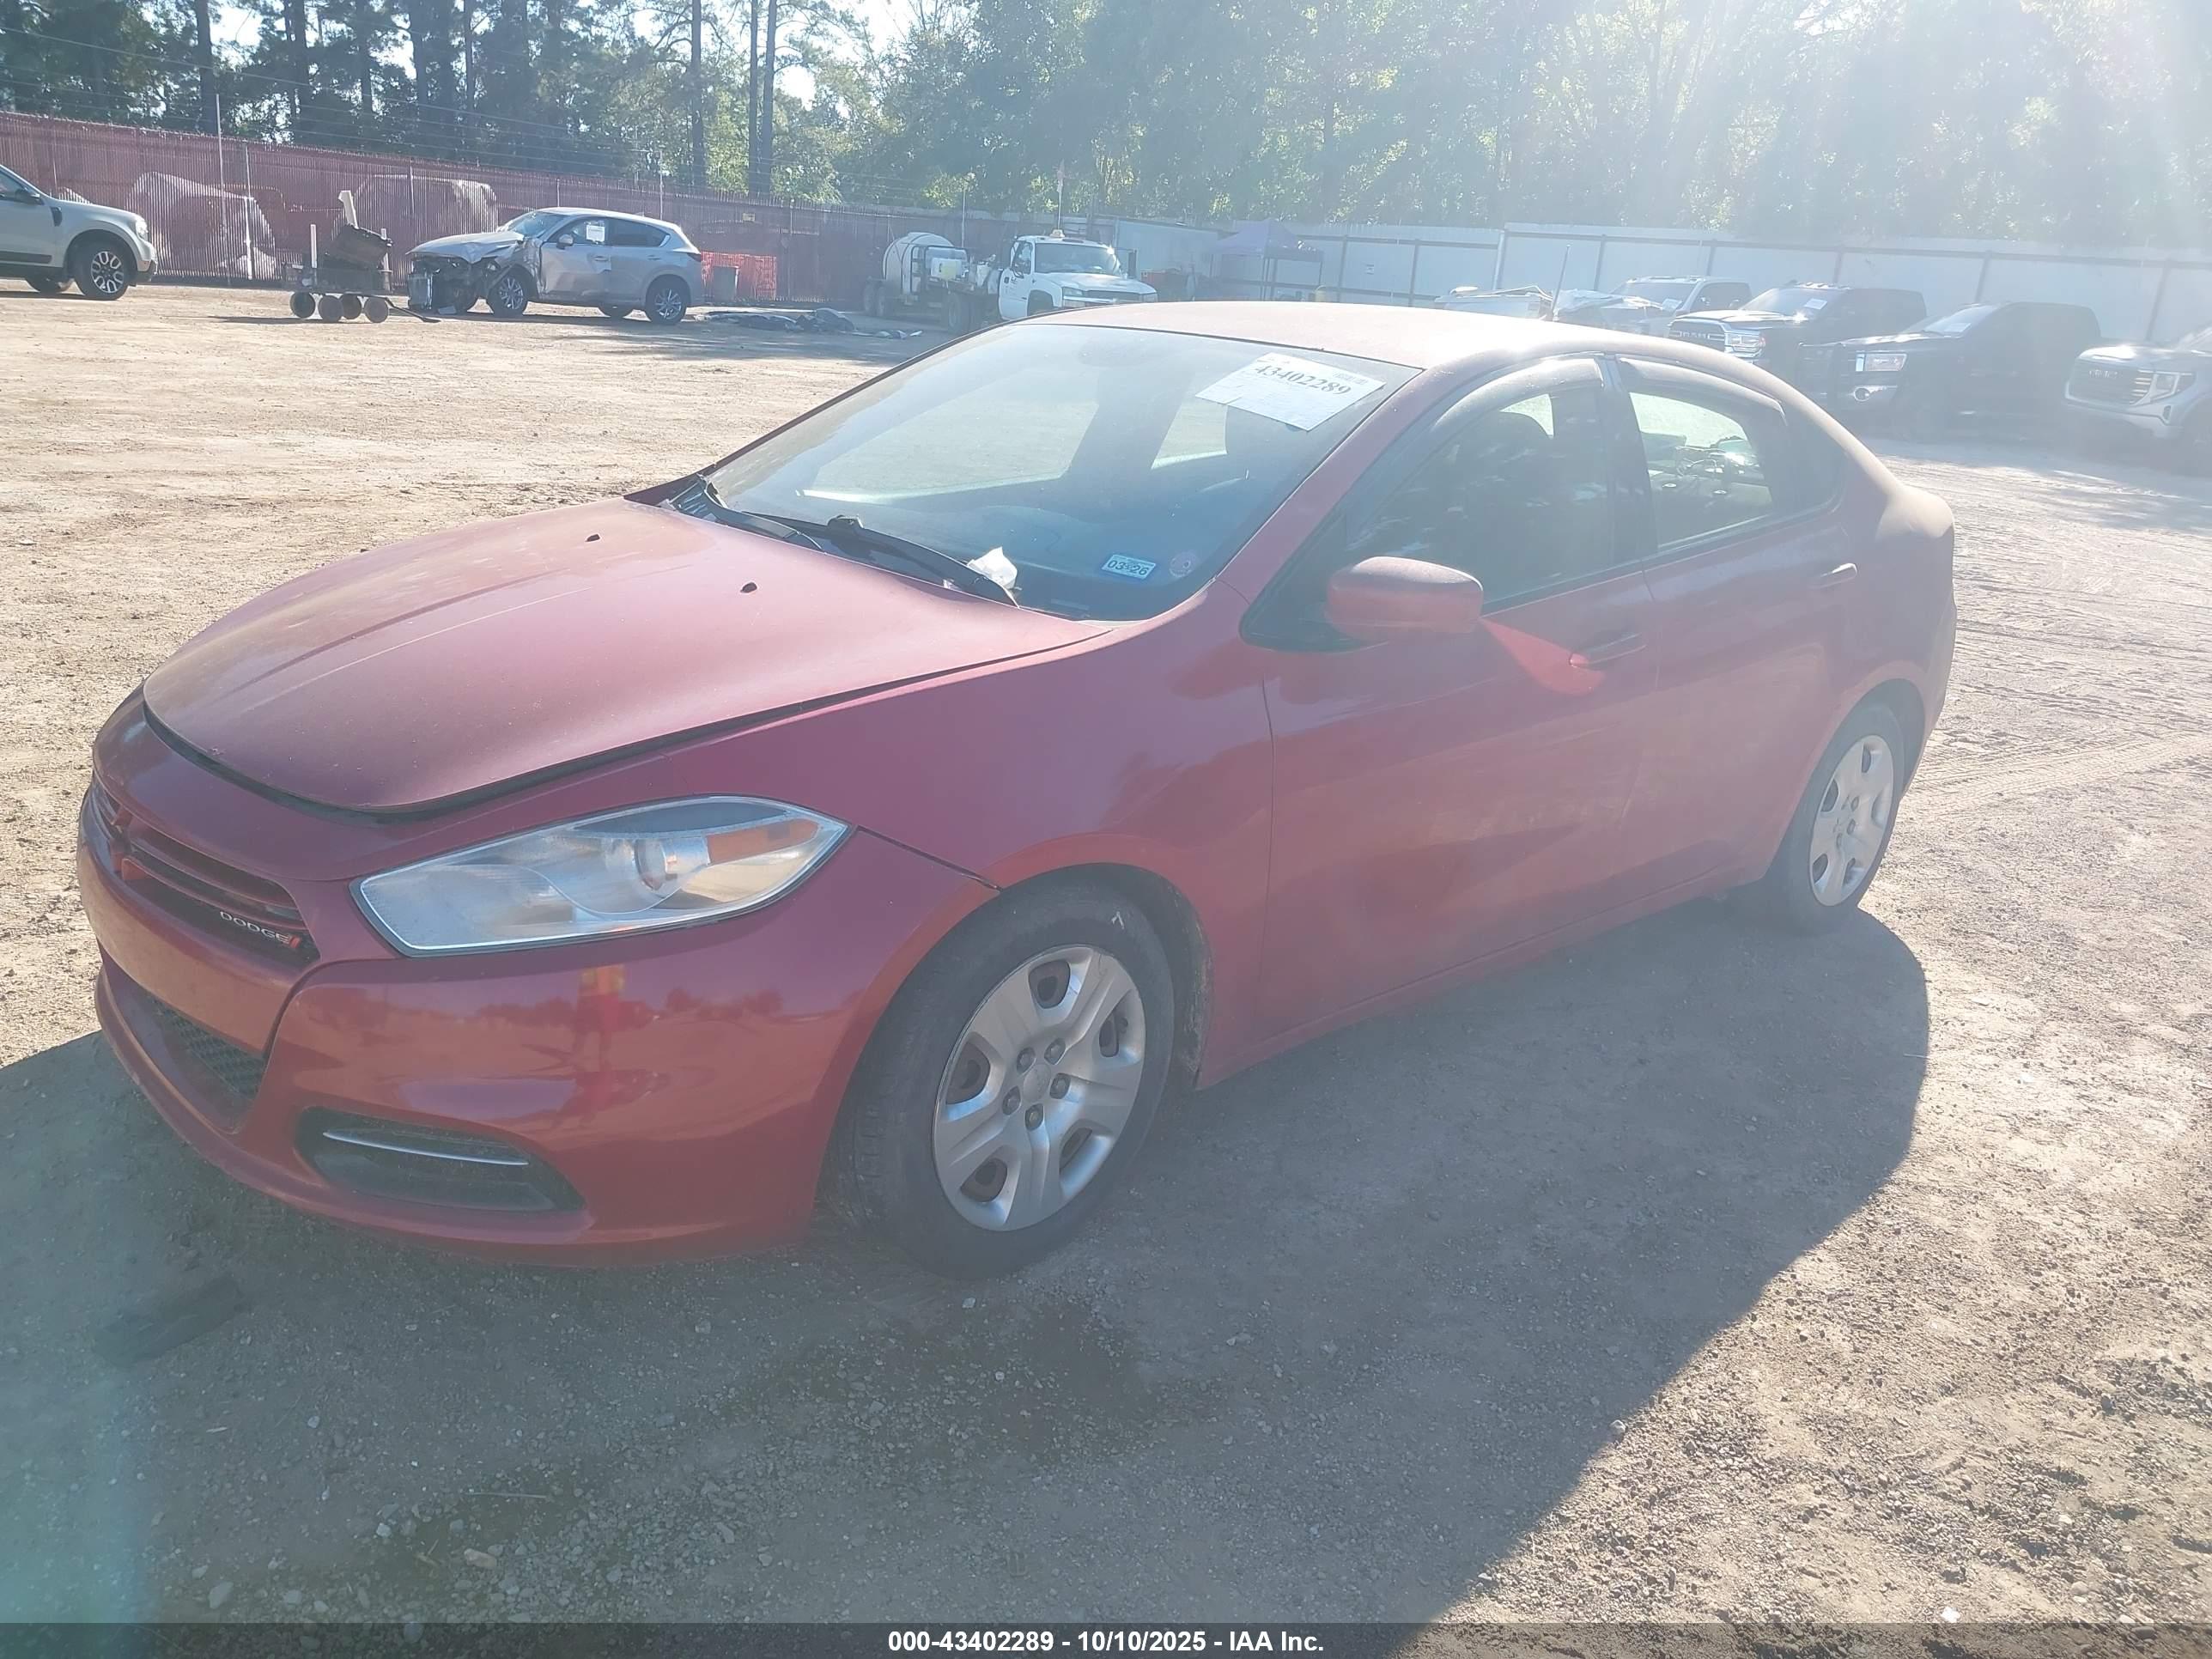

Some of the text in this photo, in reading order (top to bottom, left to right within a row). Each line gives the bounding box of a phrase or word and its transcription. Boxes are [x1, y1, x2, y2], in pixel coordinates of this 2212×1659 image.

[1255, 365, 1352, 395] 43402289
[1107, 560, 1127, 570] 03
[1130, 564, 1150, 575] 26
[220, 911, 289, 944] DODGE
